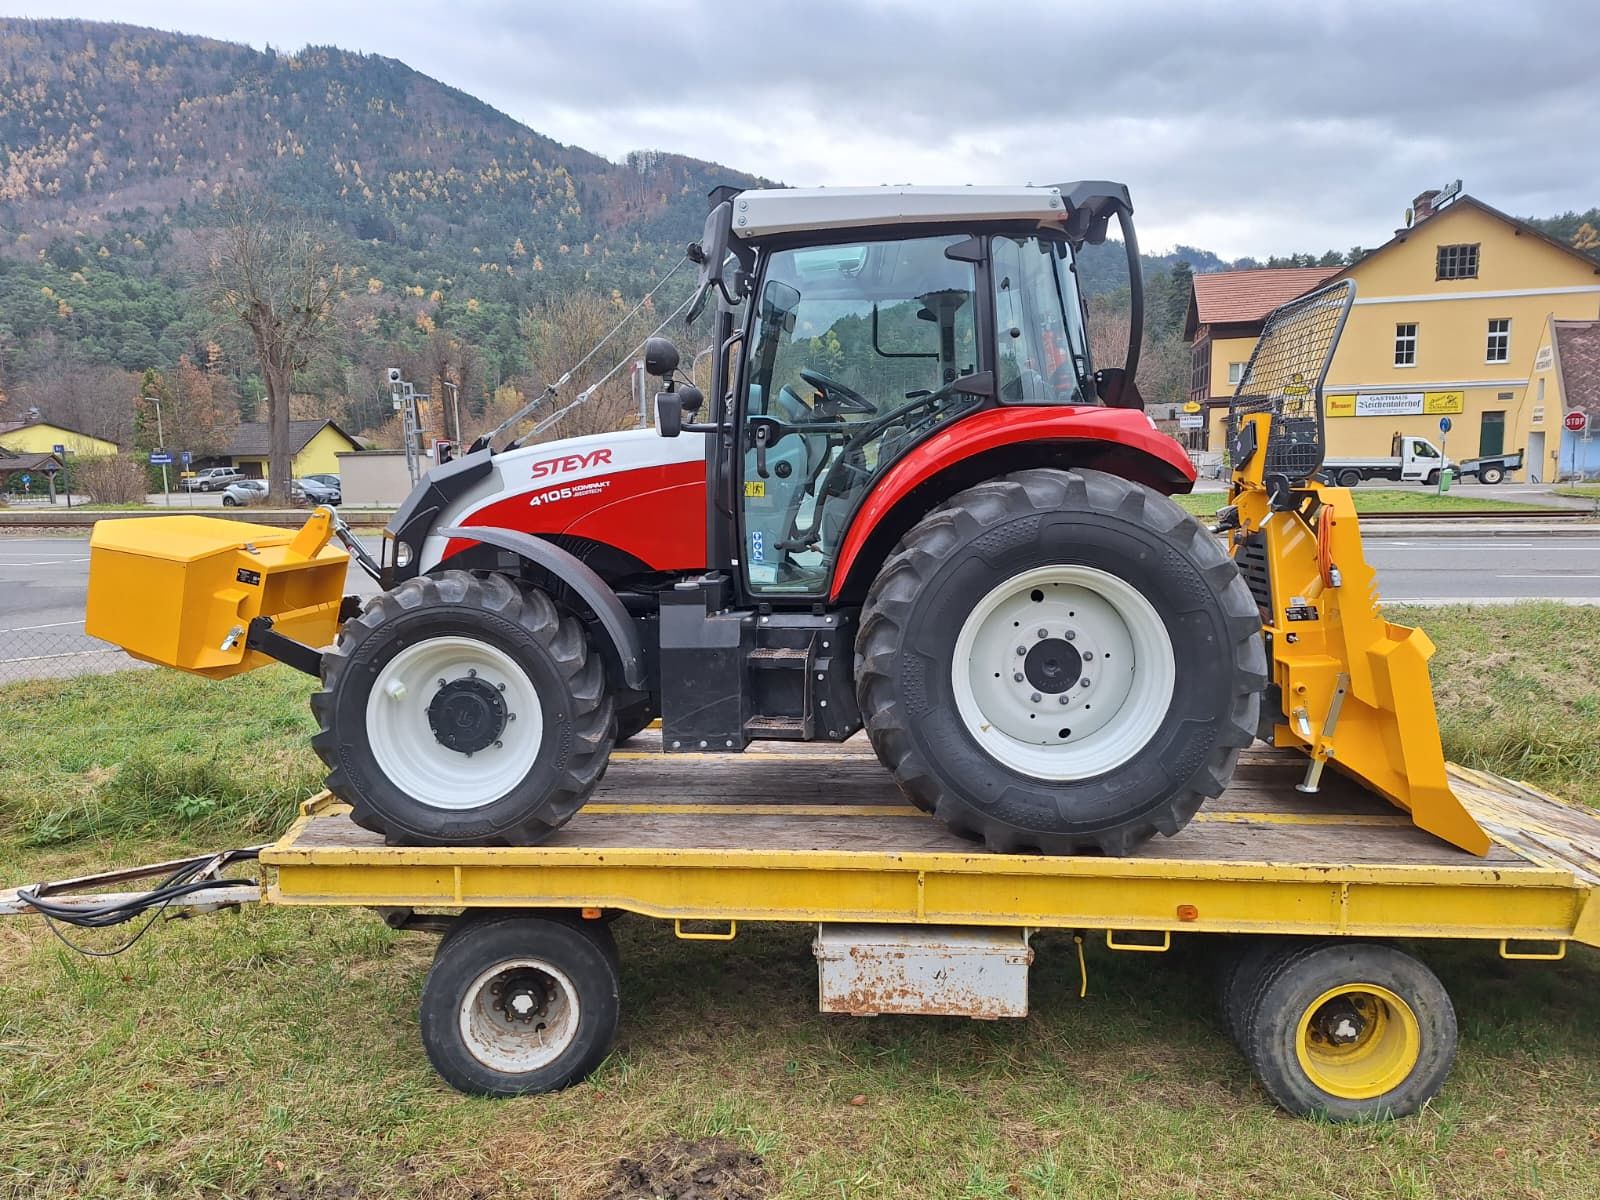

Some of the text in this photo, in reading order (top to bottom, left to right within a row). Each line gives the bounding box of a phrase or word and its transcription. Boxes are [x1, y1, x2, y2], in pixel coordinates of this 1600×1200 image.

[1566, 417, 1585, 426] STOP
[531, 448, 612, 479] STEYR
[529, 481, 611, 506] 4105 KOMPAKT
